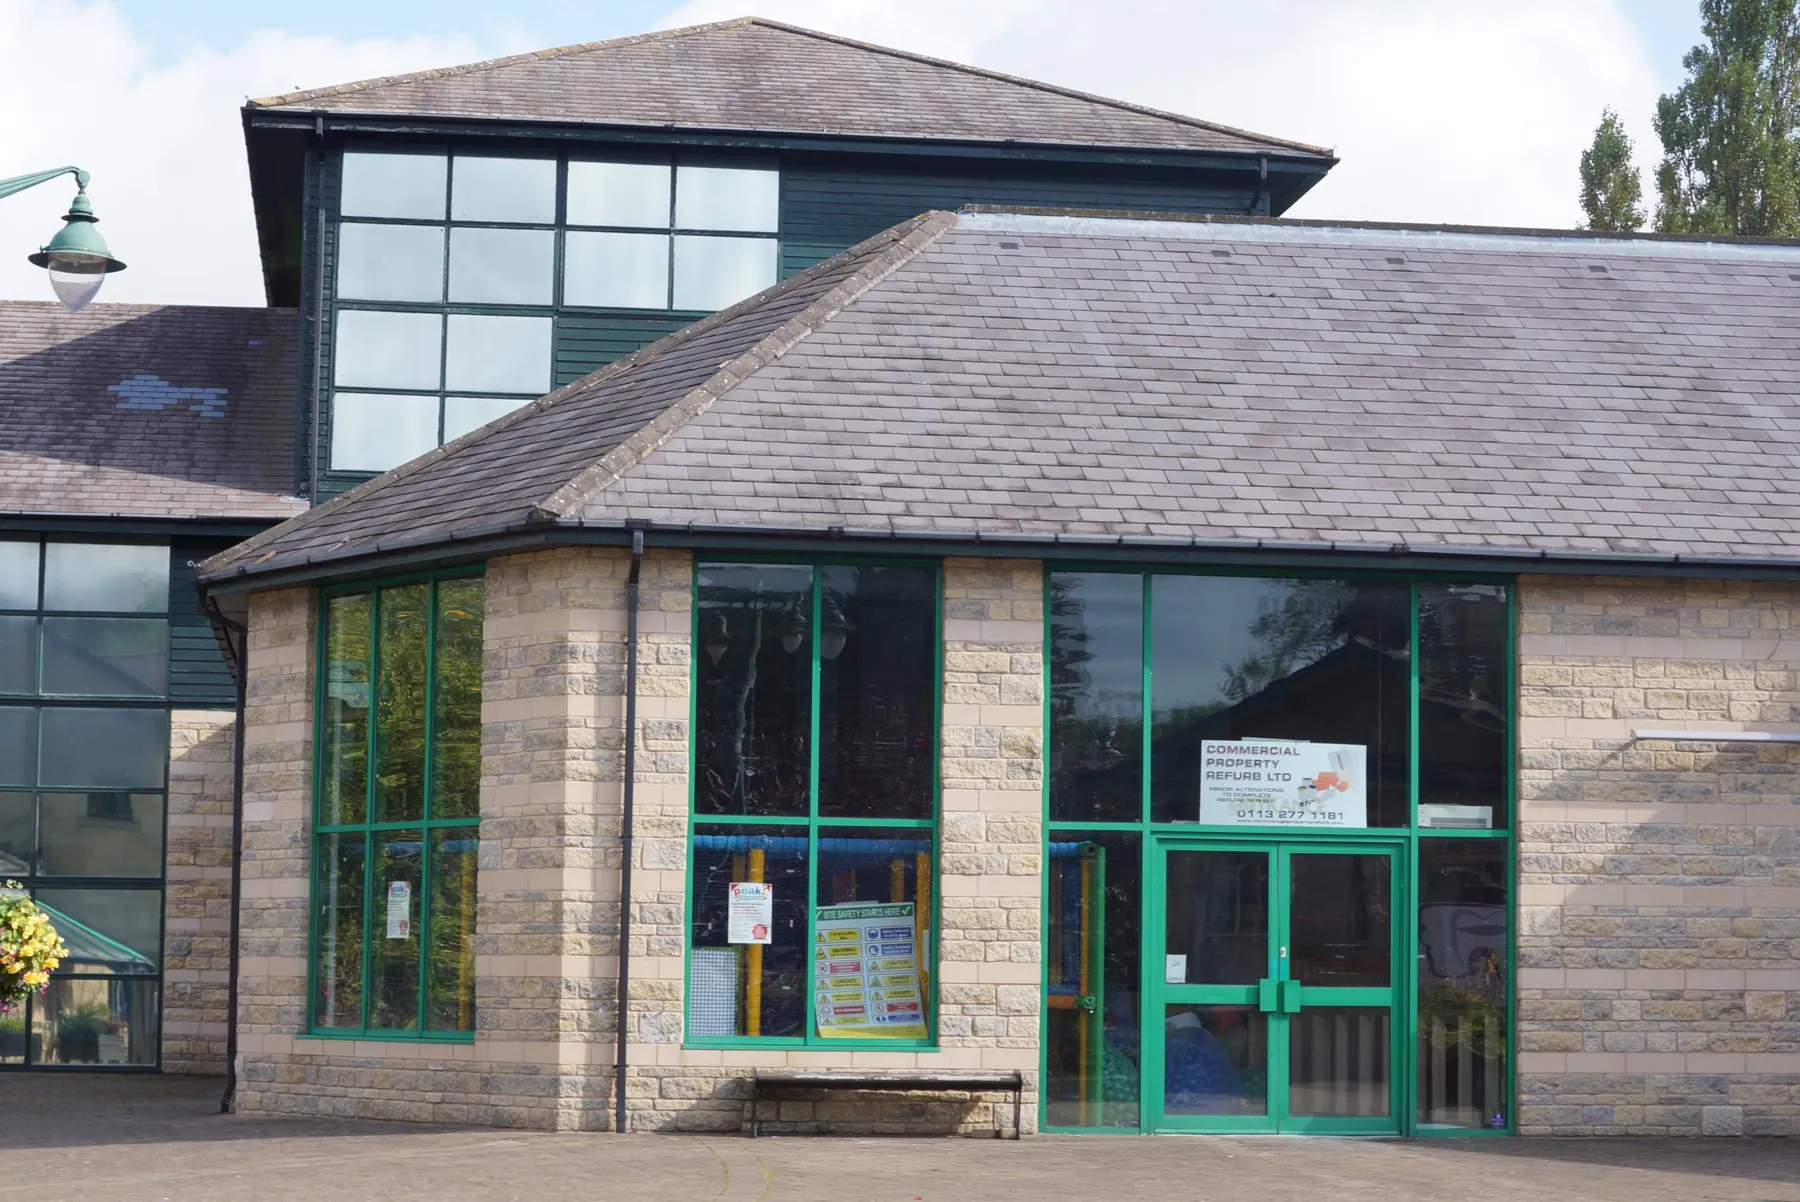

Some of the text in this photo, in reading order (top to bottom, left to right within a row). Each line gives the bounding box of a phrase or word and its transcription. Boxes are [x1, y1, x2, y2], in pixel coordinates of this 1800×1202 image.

[1206, 745, 1300, 756] COMMERCIAL
[1206, 758, 1280, 769] PROPERTY
[1206, 771, 1291, 782] REFURB LTD
[1237, 810, 1344, 820] 0113 277 1181
[823, 907, 901, 919] SITE SAFETY STARTS HERE
